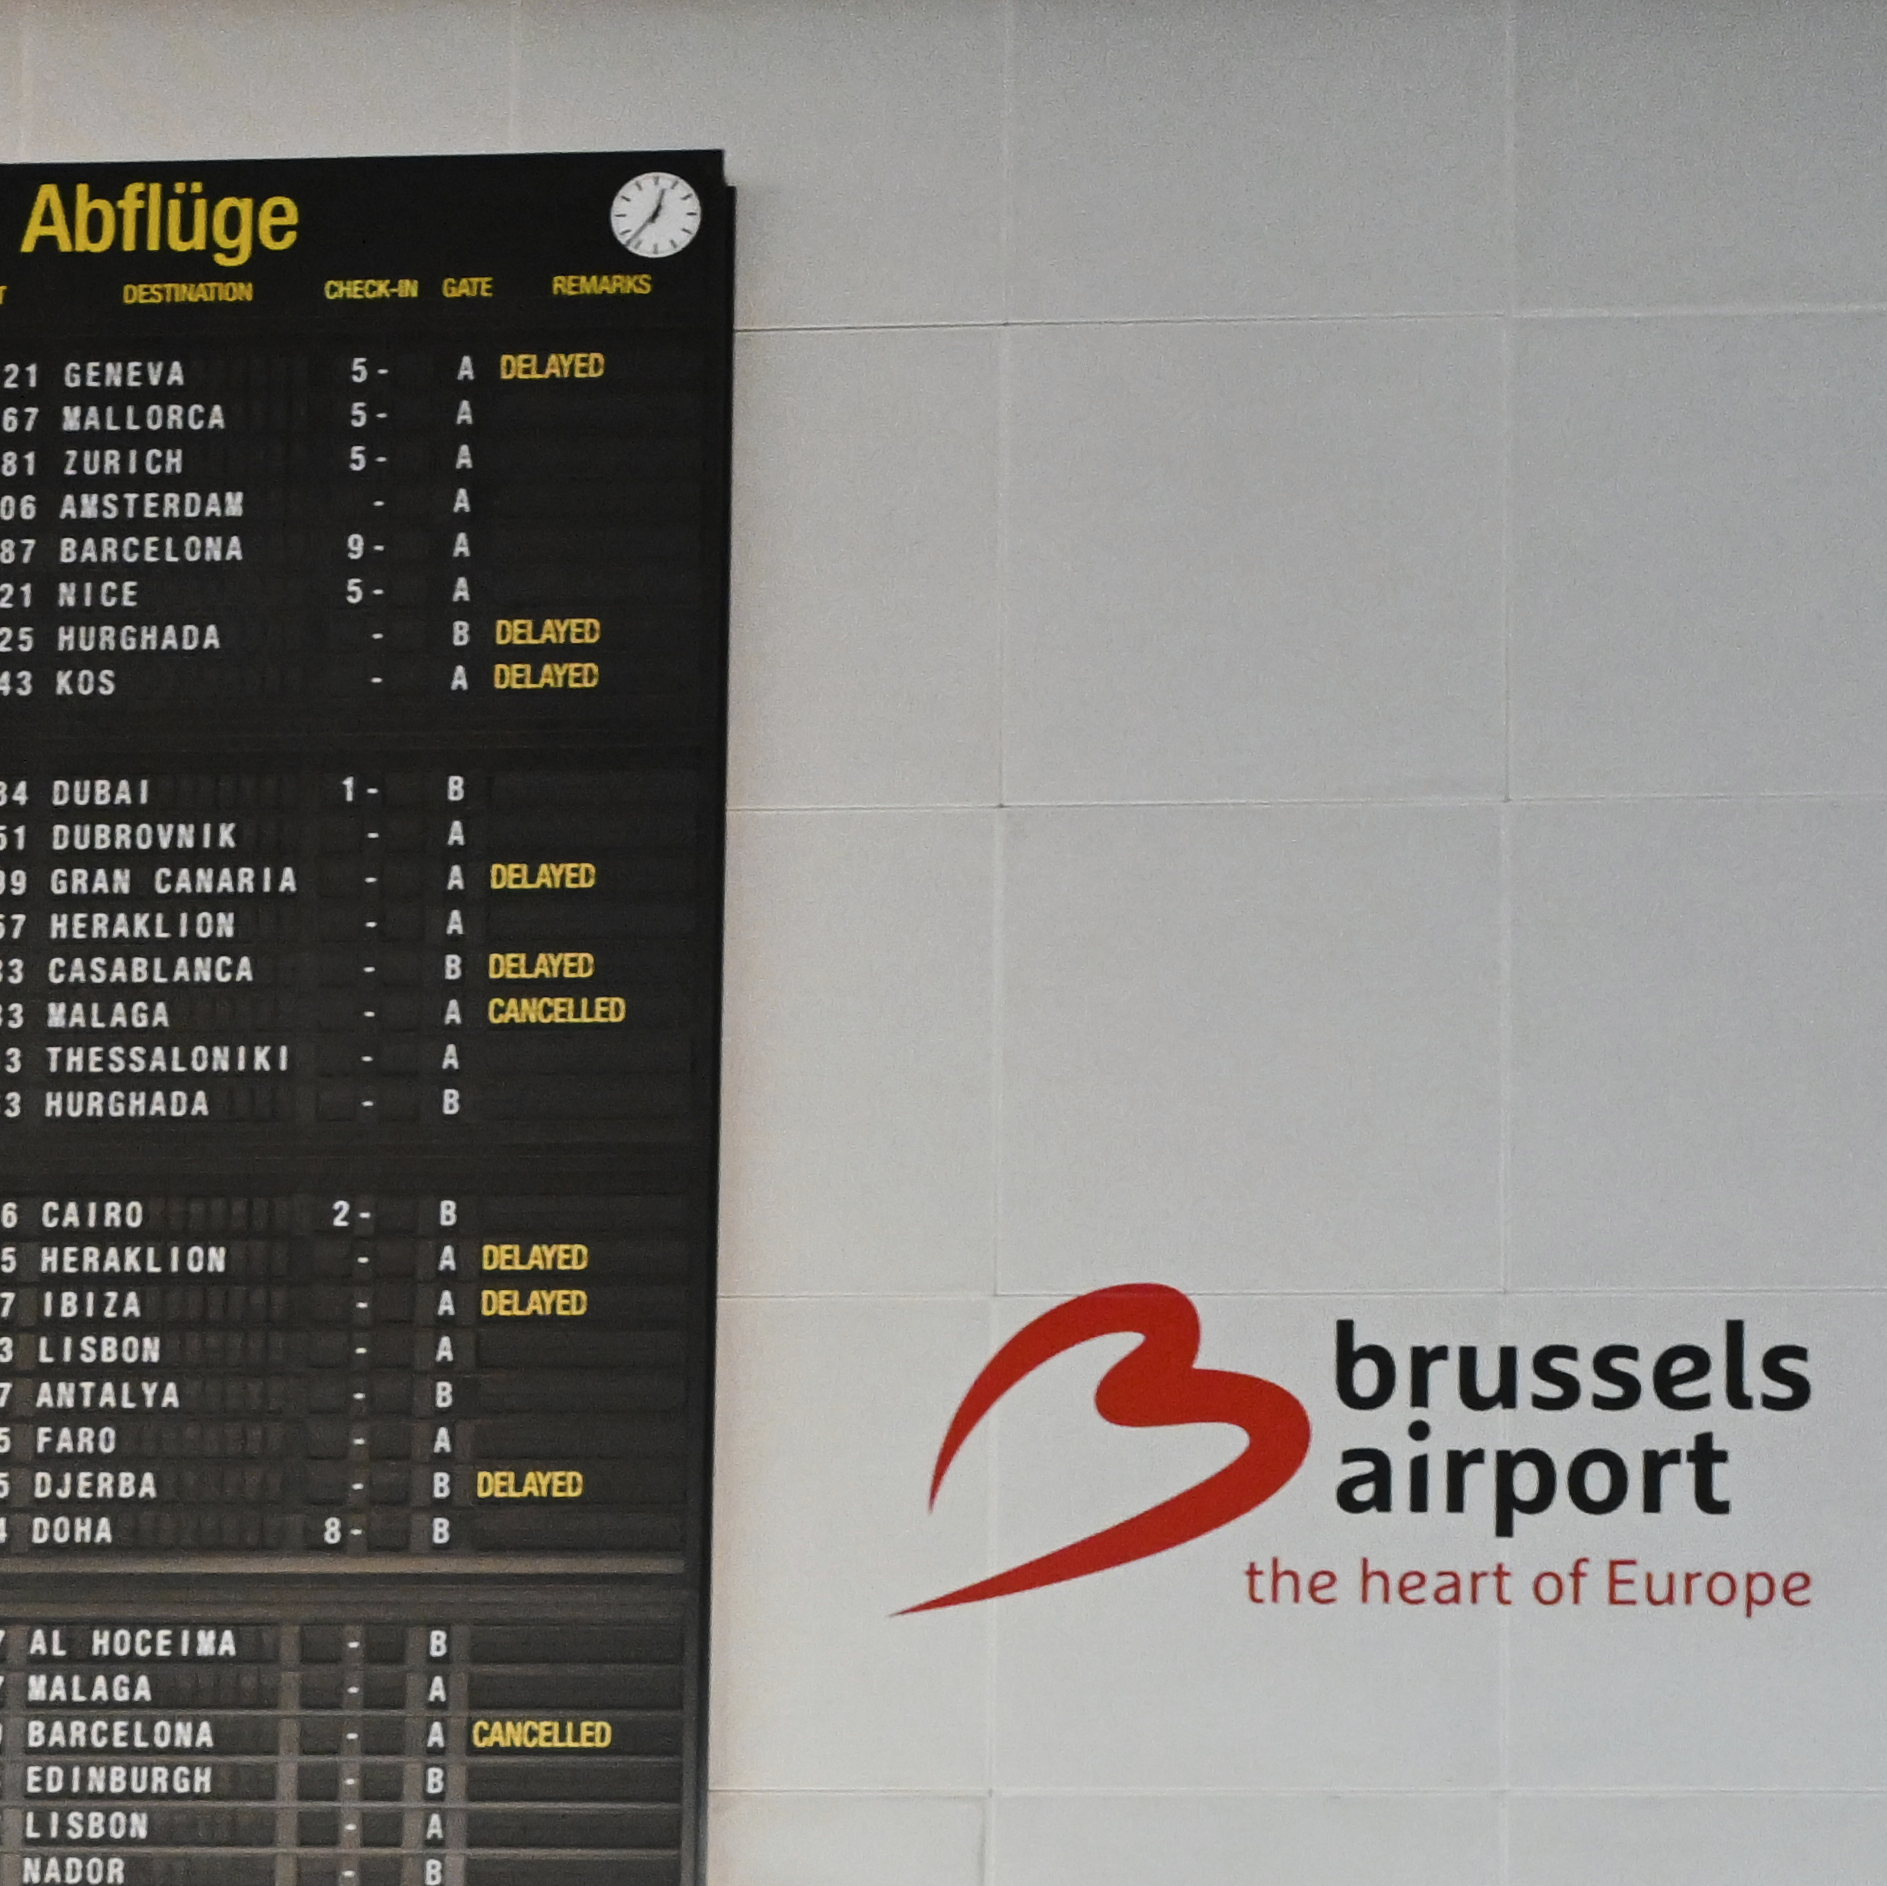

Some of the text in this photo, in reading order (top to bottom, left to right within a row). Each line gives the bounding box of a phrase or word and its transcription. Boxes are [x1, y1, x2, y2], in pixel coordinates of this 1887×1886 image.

[21, 182, 298, 266] Abflüge
[123, 282, 253, 304] DESTINATION
[325, 279, 418, 299] CHECK-IN
[443, 277, 492, 297] GATE
[553, 274, 651, 295] REMARKS
[65, 353, 604, 387] GENEVA DELAYED
[63, 404, 224, 430] MALLORCA
[64, 449, 182, 475] ZURICH
[60, 492, 243, 519] AMSTERDAM
[60, 536, 242, 563] BARCELONA
[59, 581, 137, 607] NICE
[58, 625, 219, 651] HURGHADA
[56, 663, 598, 695] KOS DELAYED
[53, 823, 235, 850] DUBROVNIK
[51, 863, 595, 894] GRAN CANARIA DELAYED
[51, 912, 234, 939] HERAKLION
[49, 956, 252, 984] CASABLANCA
[48, 997, 625, 1028] MALAGA CANCELLED
[47, 1046, 287, 1072] THESSALONIKI
[42, 1201, 142, 1227] CAIRO
[41, 1244, 588, 1273] HERAKLION DELAYED
[44, 1291, 140, 1318] IBIZA
[39, 1336, 160, 1363] LISBON
[1336, 1319, 1811, 1411] brussels
[36, 1382, 179, 1408] ANTALYA
[37, 1427, 115, 1453] FARO
[35, 1471, 583, 1498] DJERBA DELAYED
[1336, 1420, 1730, 1538] airport
[1245, 1557, 1811, 1618] the heart of Europe
[28, 1674, 151, 1701] MALAGA
[28, 1720, 213, 1748] BARCELONA
[473, 1720, 611, 1747] CANCELLED
[27, 1766, 211, 1793] EDINBURGH
[26, 1811, 147, 1839] LISBON
[23, 1857, 124, 1884] NADOR
